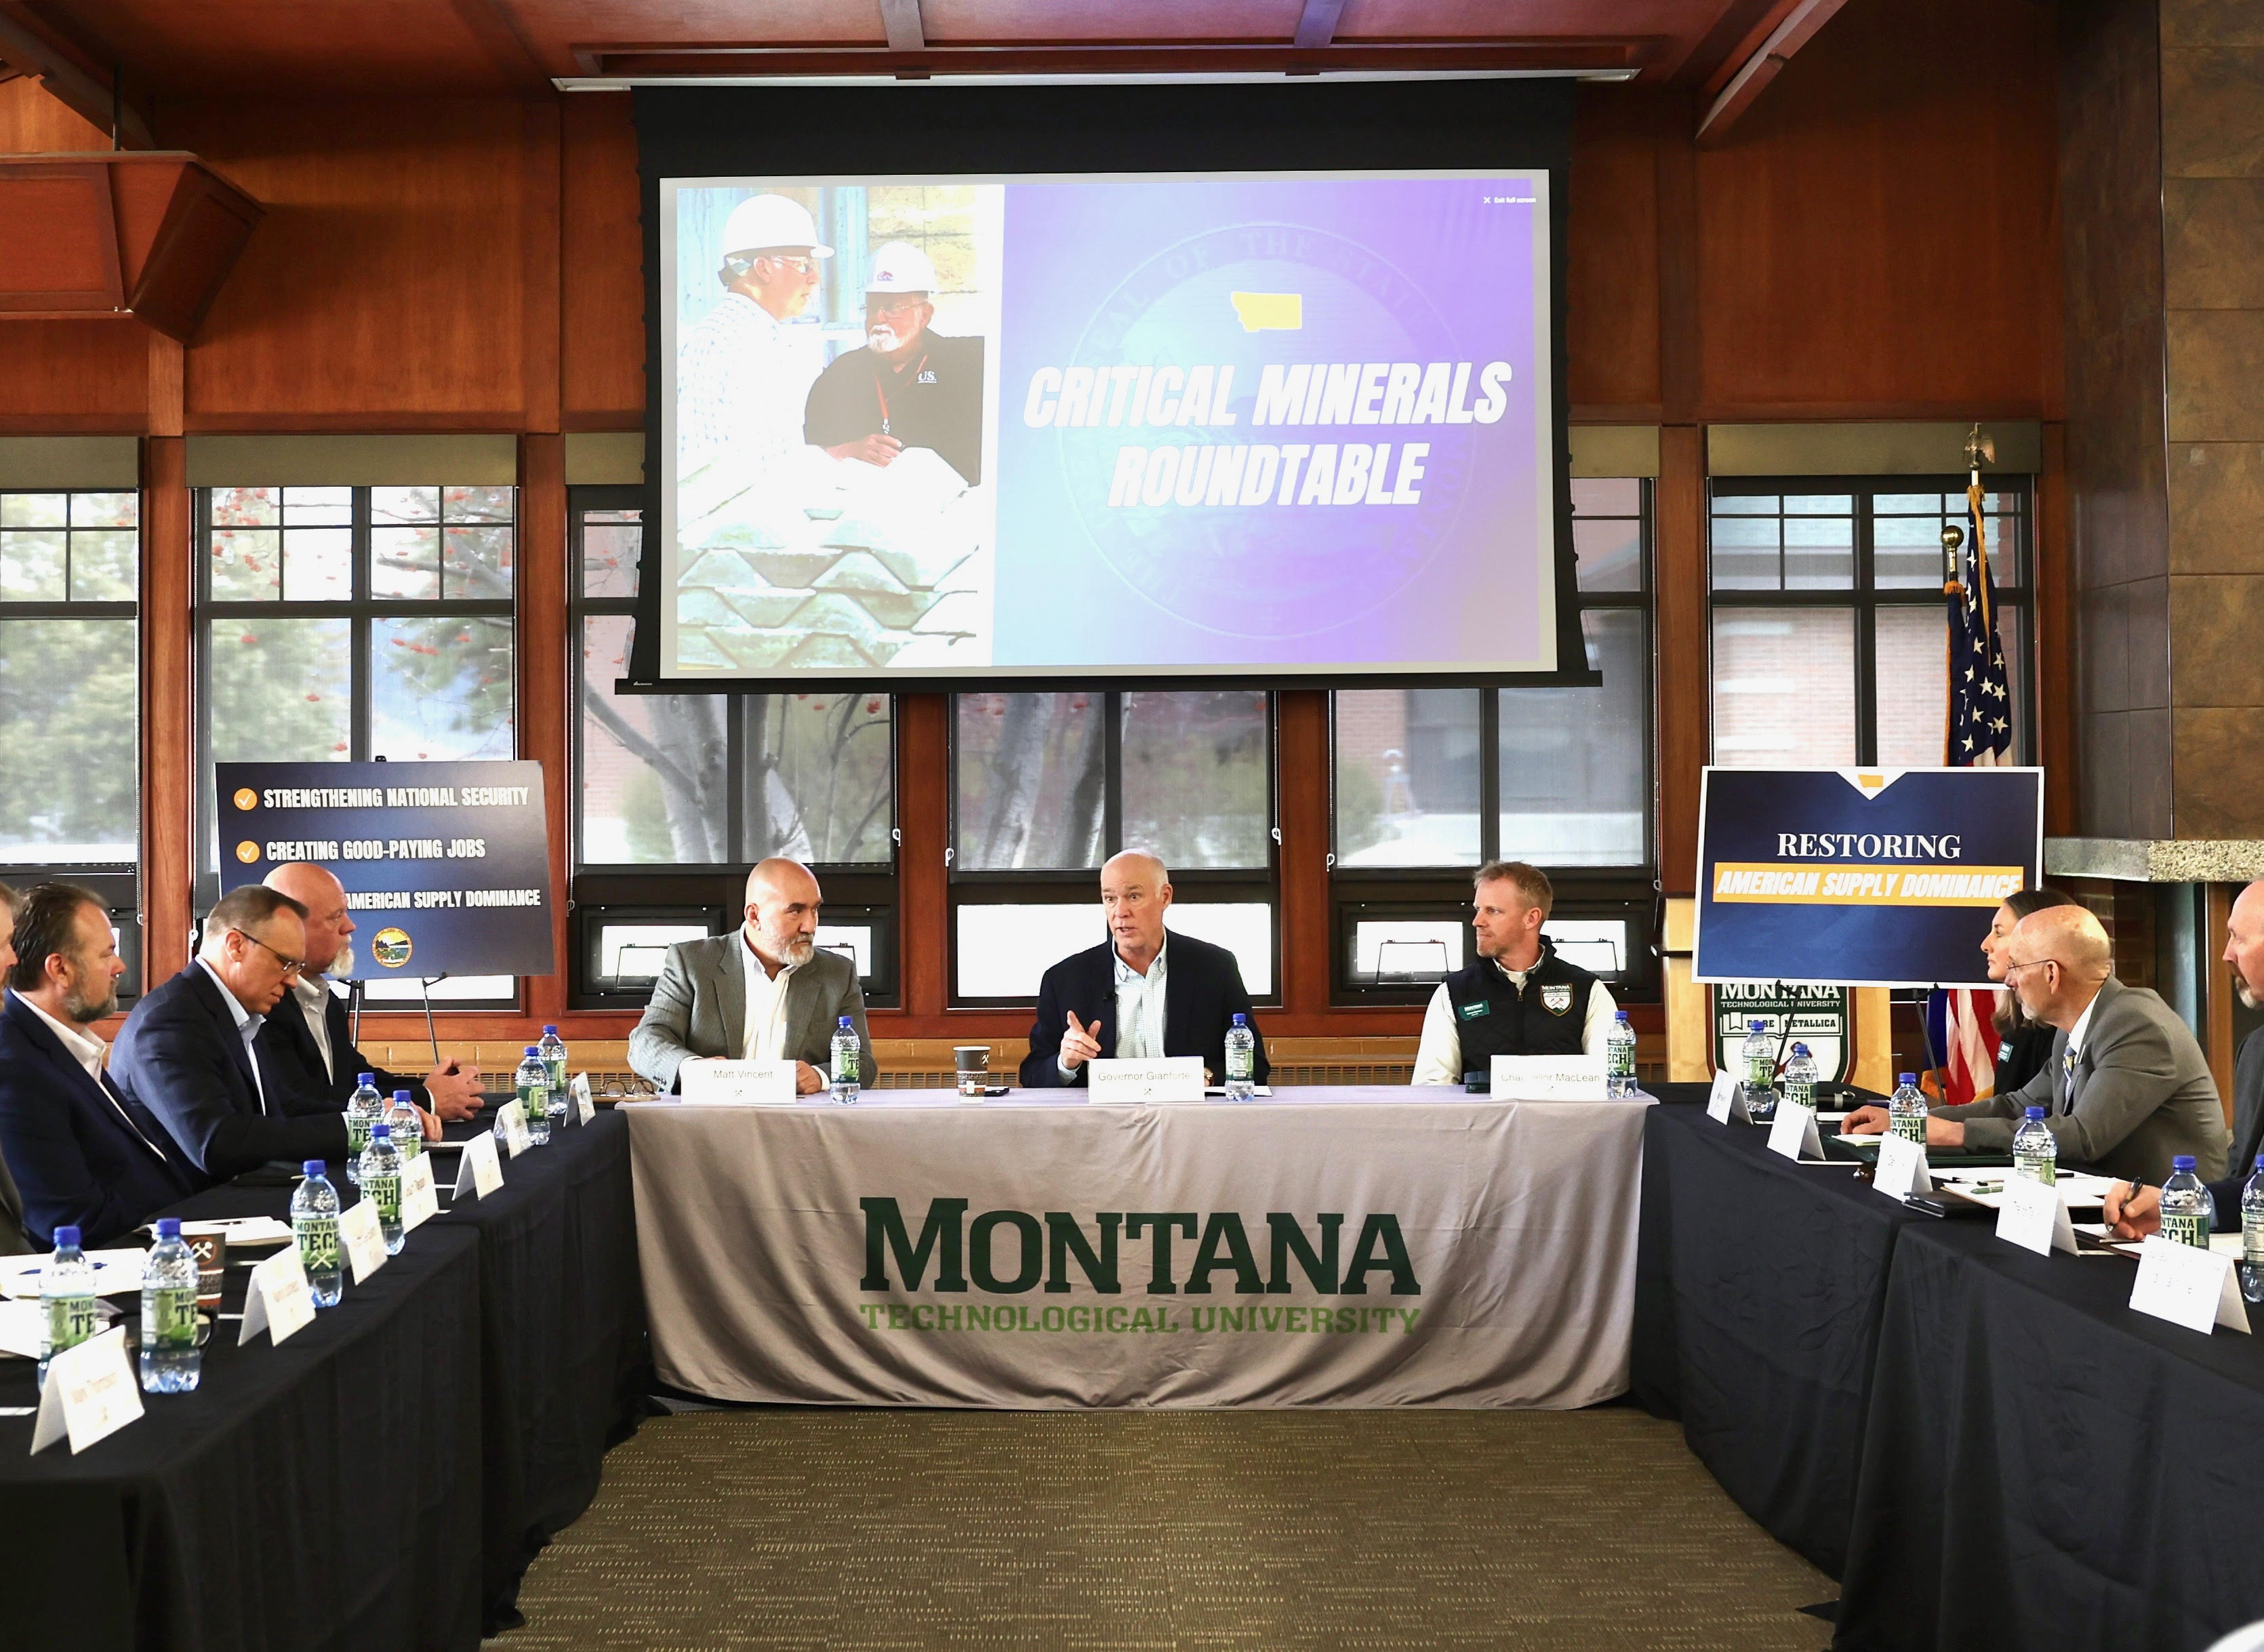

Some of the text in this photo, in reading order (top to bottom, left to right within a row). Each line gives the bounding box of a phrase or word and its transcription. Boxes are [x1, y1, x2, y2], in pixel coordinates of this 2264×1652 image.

[1023, 361, 1512, 428] CRITICAL MINERALS
[1107, 442, 1431, 507] ROUNDTABLE
[264, 787, 529, 808] STRENGTHENING NATIONAL SECURITY
[266, 839, 486, 861] CREATING GOOD-PAYING JOBS
[1777, 833, 1962, 859] RESTORING
[1716, 871, 2021, 899] AMERICAN SUPPLY DOMINANCE
[345, 889, 541, 910] AMERICAN SUPPLY DOMINANCE
[714, 1069, 773, 1079] Matt Vincent
[1098, 1070, 1191, 1081] Governor Gianforte
[1501, 1073, 1600, 1082] Chaellor MacLean
[860, 1197, 1421, 1295] MONTANA
[860, 1304, 1421, 1336] TECHNOLOGICAL UNIVERSITY
